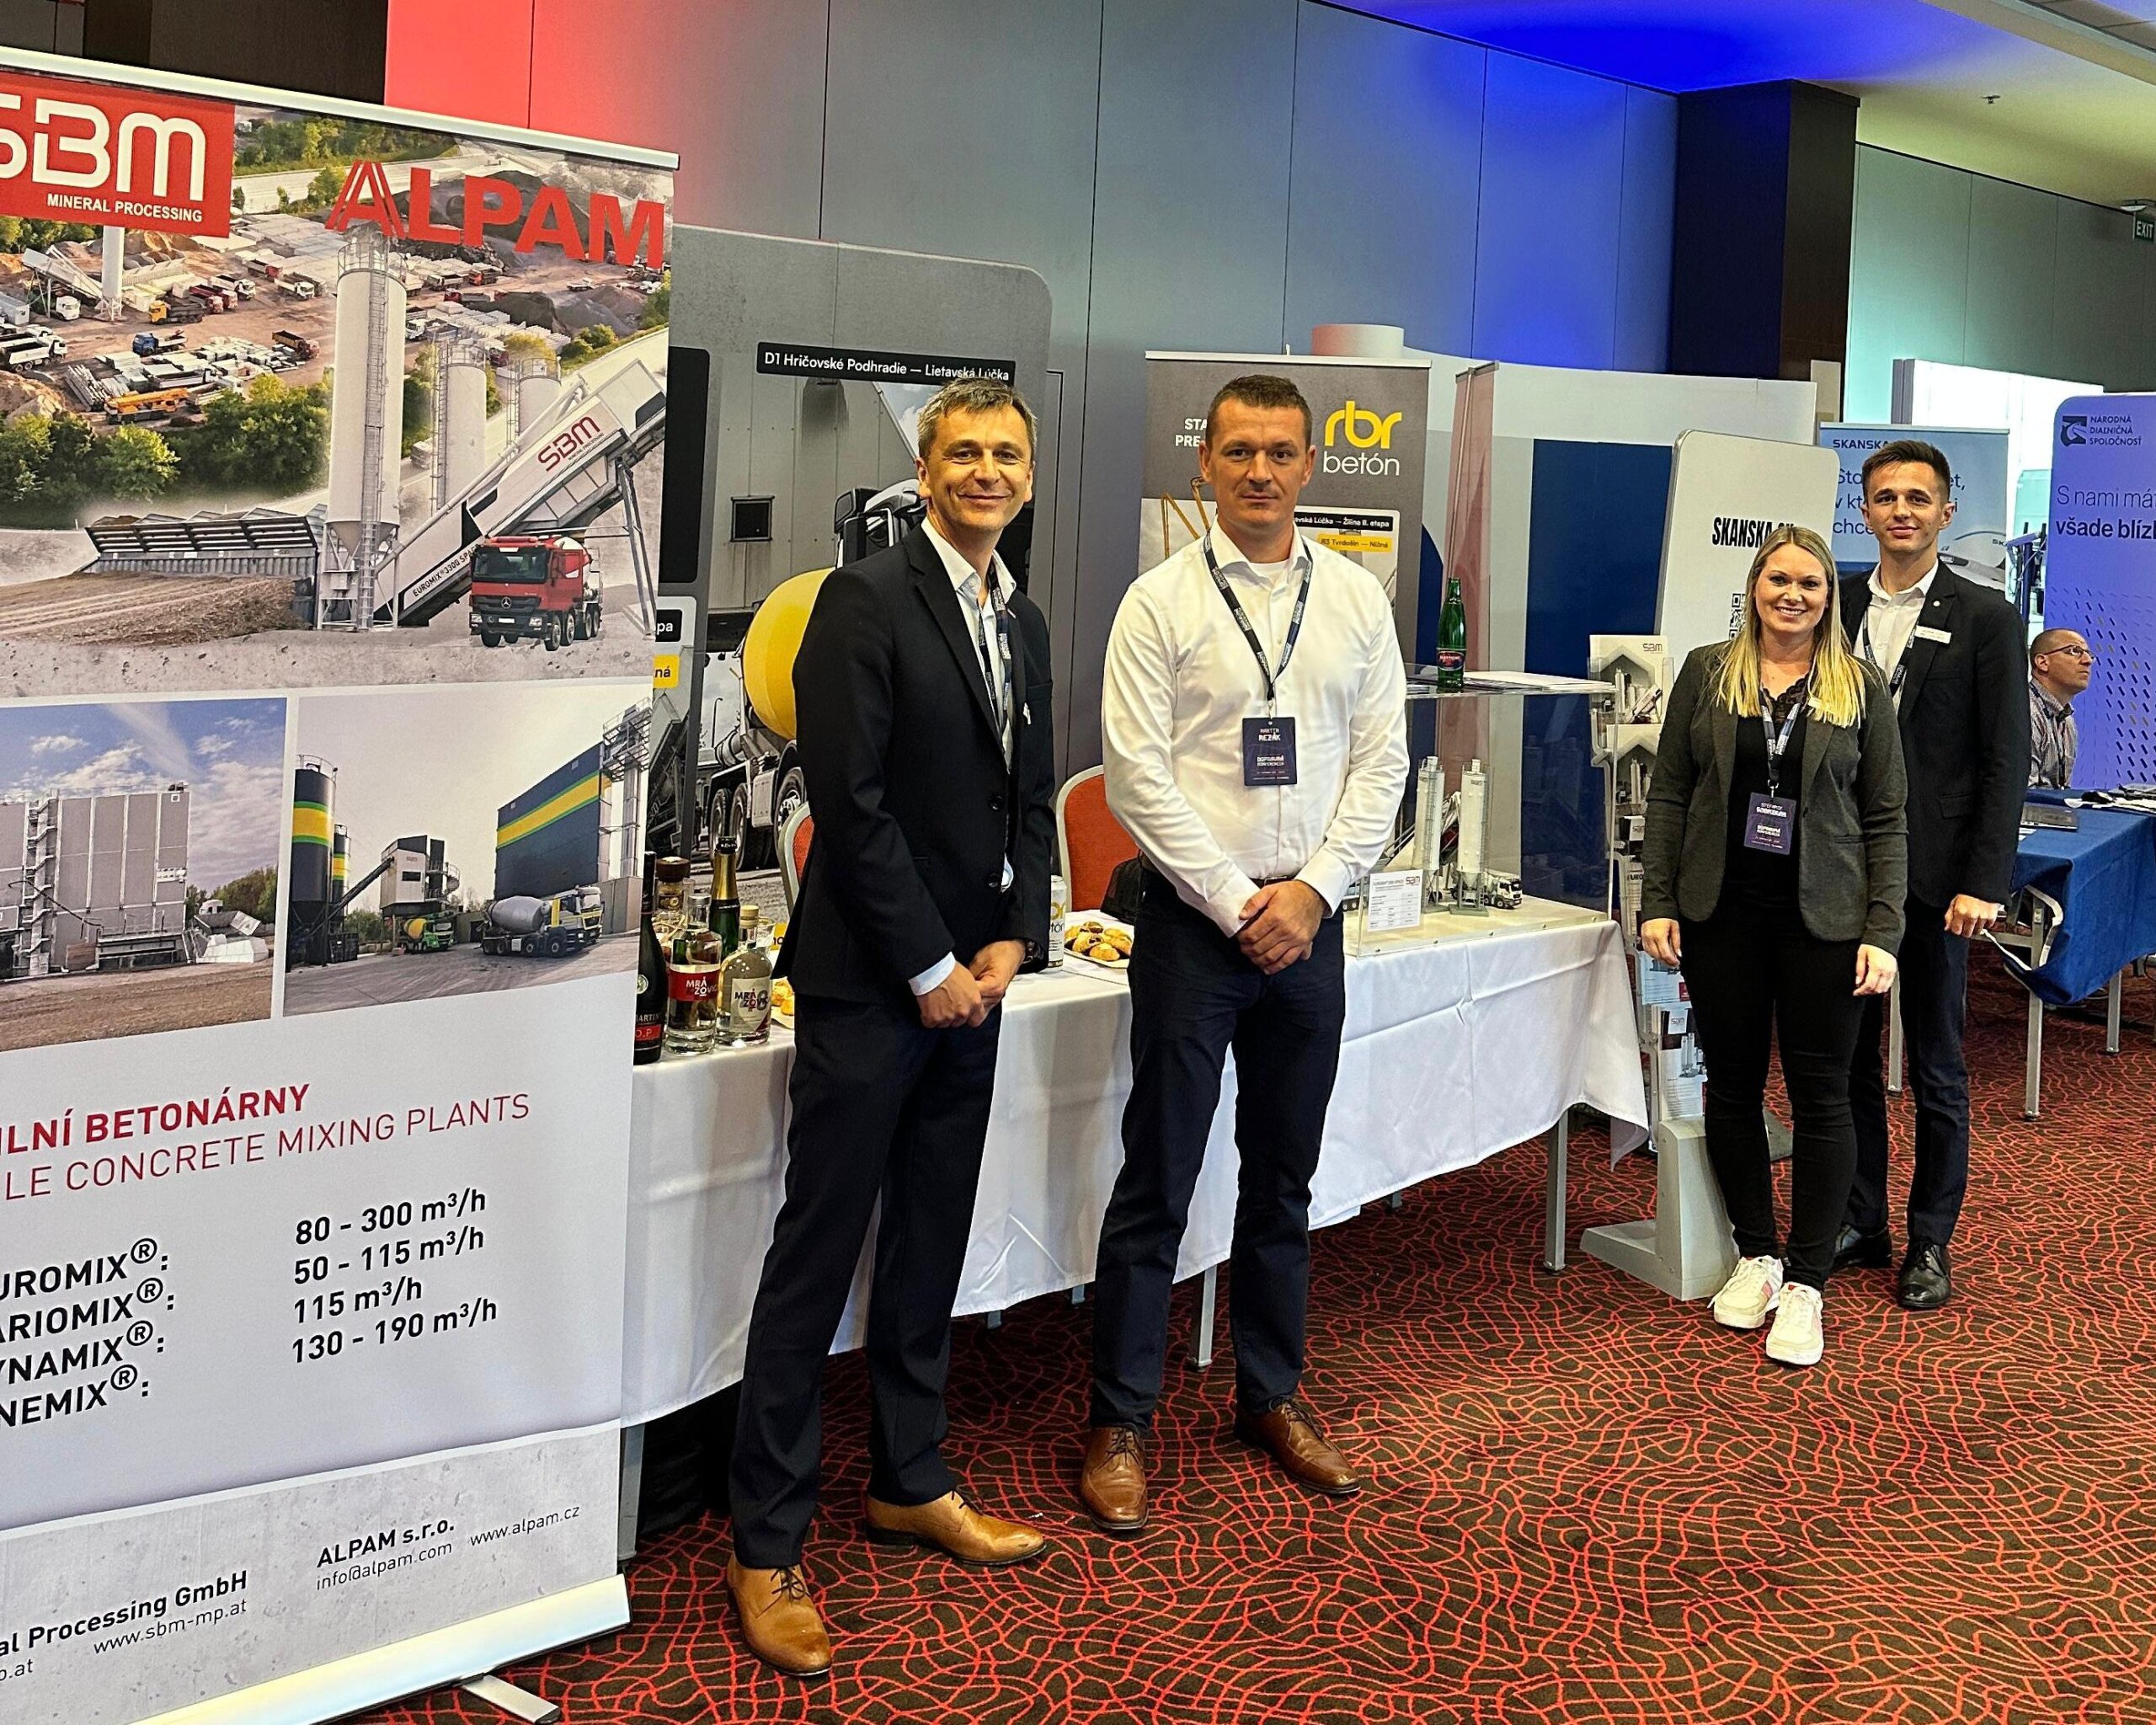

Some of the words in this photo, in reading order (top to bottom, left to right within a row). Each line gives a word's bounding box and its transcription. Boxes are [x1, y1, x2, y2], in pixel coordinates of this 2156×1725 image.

[47, 193, 110, 213] MINERAL
[115, 200, 203, 222] PROCESSING
[325, 159, 664, 269] ALPAM
[2136, 221, 2153, 238] EXIT
[765, 352, 781, 366] D1
[784, 352, 844, 371] Hričovské
[847, 359, 907, 375] Podhradie
[926, 364, 975, 378] Lietavská
[1325, 401, 1401, 449] rbr
[2090, 414, 2132, 423] NÁRODNÁ
[537, 416, 600, 472] SBM
[1323, 451, 1400, 476] betón
[2057, 485, 2069, 505] S
[2074, 487, 2119, 506] nami
[2123, 488, 2156, 509] má
[2056, 516, 2114, 538] všade
[0, 1108, 73, 1155] LNÍ
[86, 1083, 310, 1143] BETONÁRNY
[67, 1133, 265, 1191] CONCRETE
[279, 1114, 395, 1157] MIXING
[407, 1093, 530, 1136] PLANTS
[296, 1216, 330, 1245] 80
[361, 1202, 412, 1232] 300
[0, 1278, 174, 1343] RIOMIX®:
[294, 1256, 328, 1284] 50
[361, 1239, 411, 1271] 115
[294, 1290, 344, 1323] 115
[292, 1330, 343, 1364] 130
[376, 1312, 424, 1345] 190
[317, 1529, 395, 1567] ALPAM
[403, 1519, 455, 1544] s.r.o.
[317, 1542, 452, 1590] info@alpam.com
[470, 1505, 580, 1546] www.alpam.cz
[29, 1596, 167, 1648] Processing
[175, 1570, 247, 1607] GmbH
[93, 1599, 247, 1653] www.sbm-mp.at
